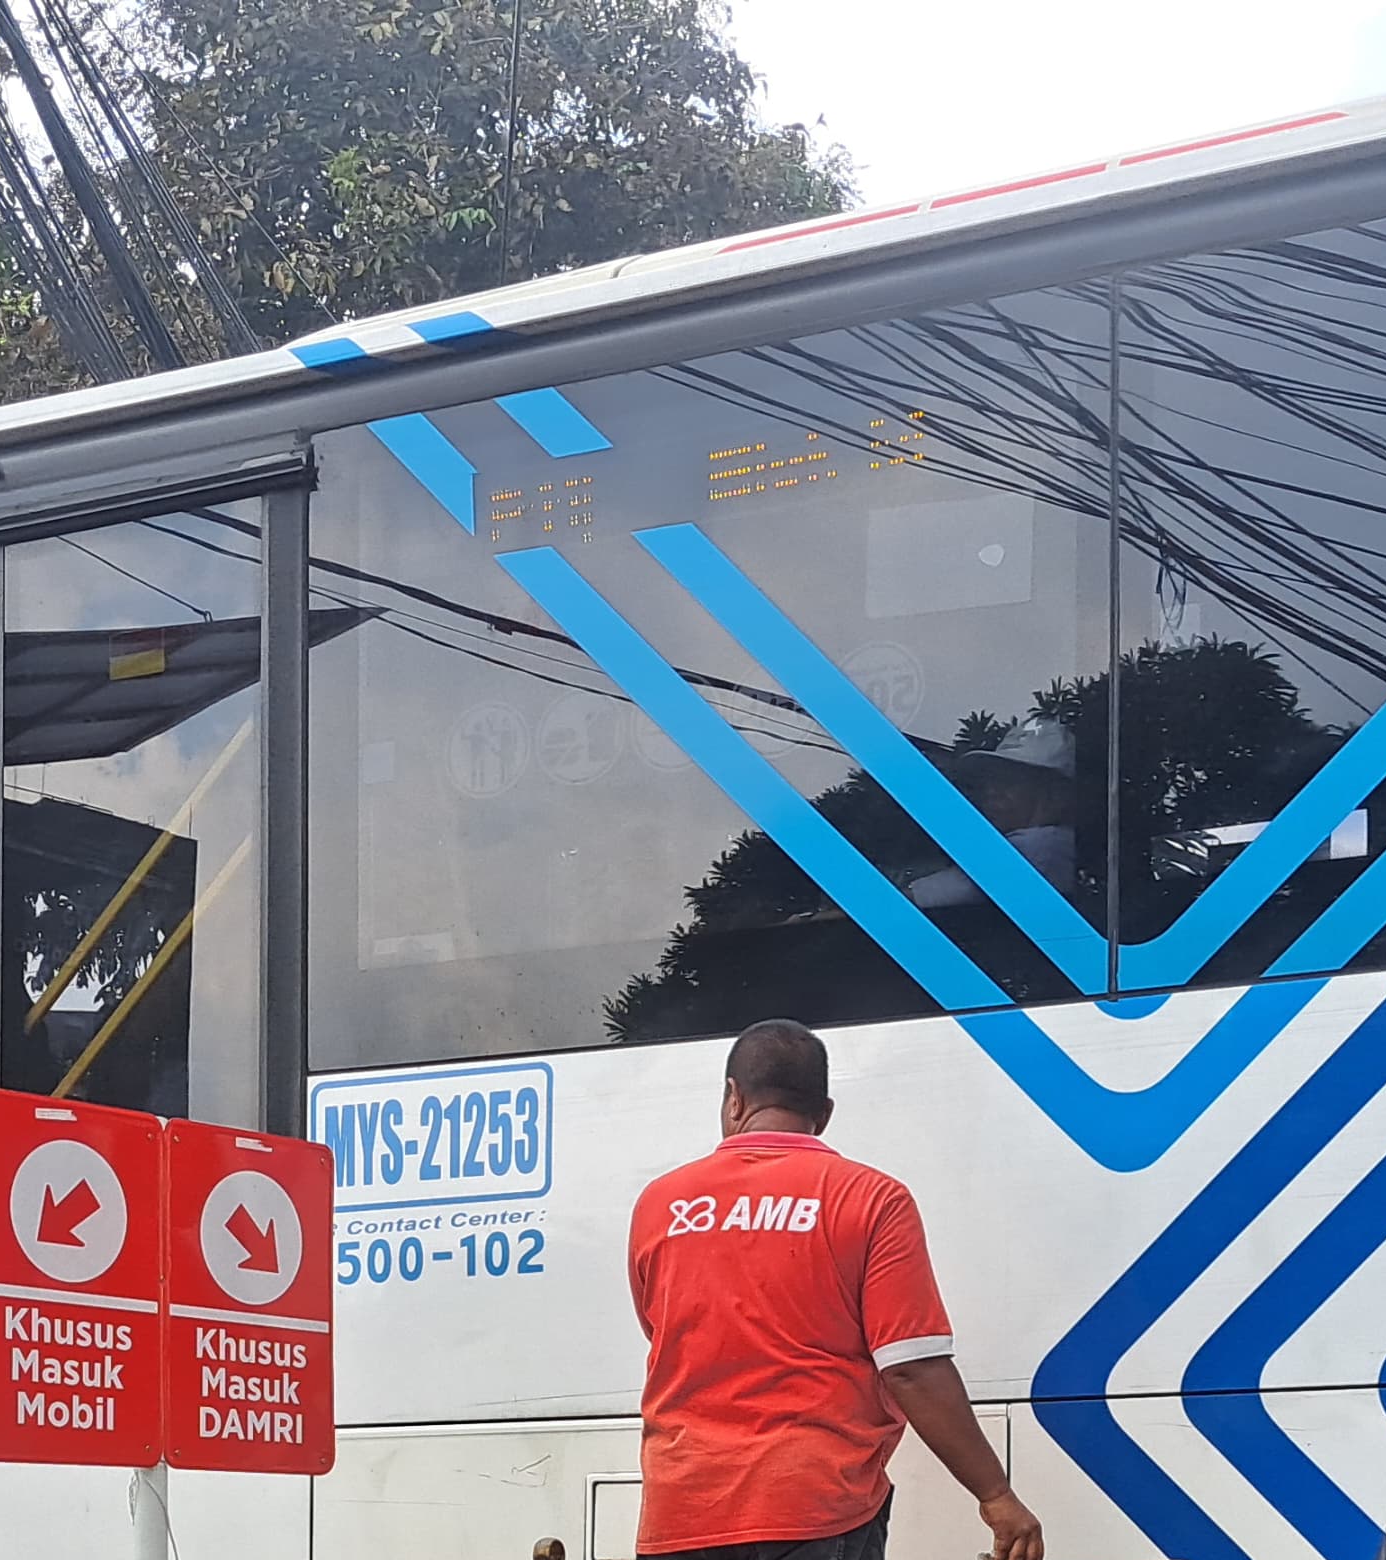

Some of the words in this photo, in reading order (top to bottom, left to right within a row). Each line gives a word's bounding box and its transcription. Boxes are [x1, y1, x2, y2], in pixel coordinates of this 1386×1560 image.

[324, 1087, 539, 1188] MYS-21253
[347, 1215, 442, 1235] Contact
[719, 1195, 821, 1232] AMB
[4, 1305, 132, 1351] Khusus
[195, 1326, 308, 1369] Khusus
[11, 1347, 124, 1390] Masuk
[201, 1365, 301, 1405] Masuk
[16, 1391, 115, 1431] Mobil
[199, 1405, 303, 1444] DAMRI
